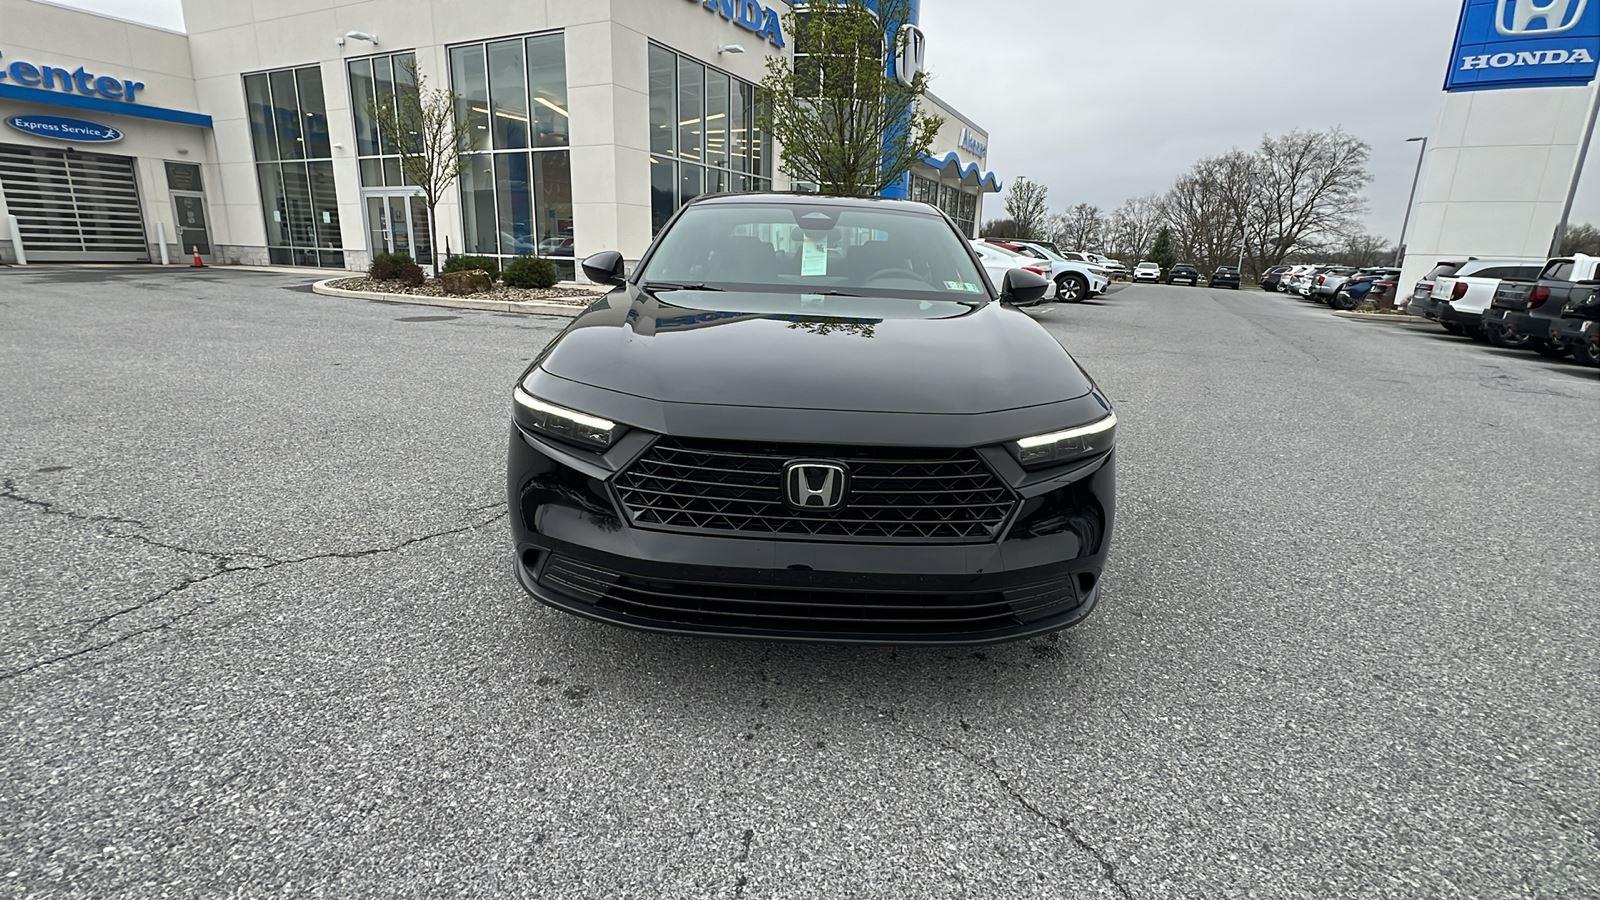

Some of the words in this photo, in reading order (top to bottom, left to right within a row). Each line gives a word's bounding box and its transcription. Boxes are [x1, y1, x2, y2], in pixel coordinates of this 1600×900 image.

[684, 0, 785, 48] NDA
[1460, 48, 1594, 71] HONDA
[15, 118, 59, 132] Express
[61, 124, 101, 136] Service
